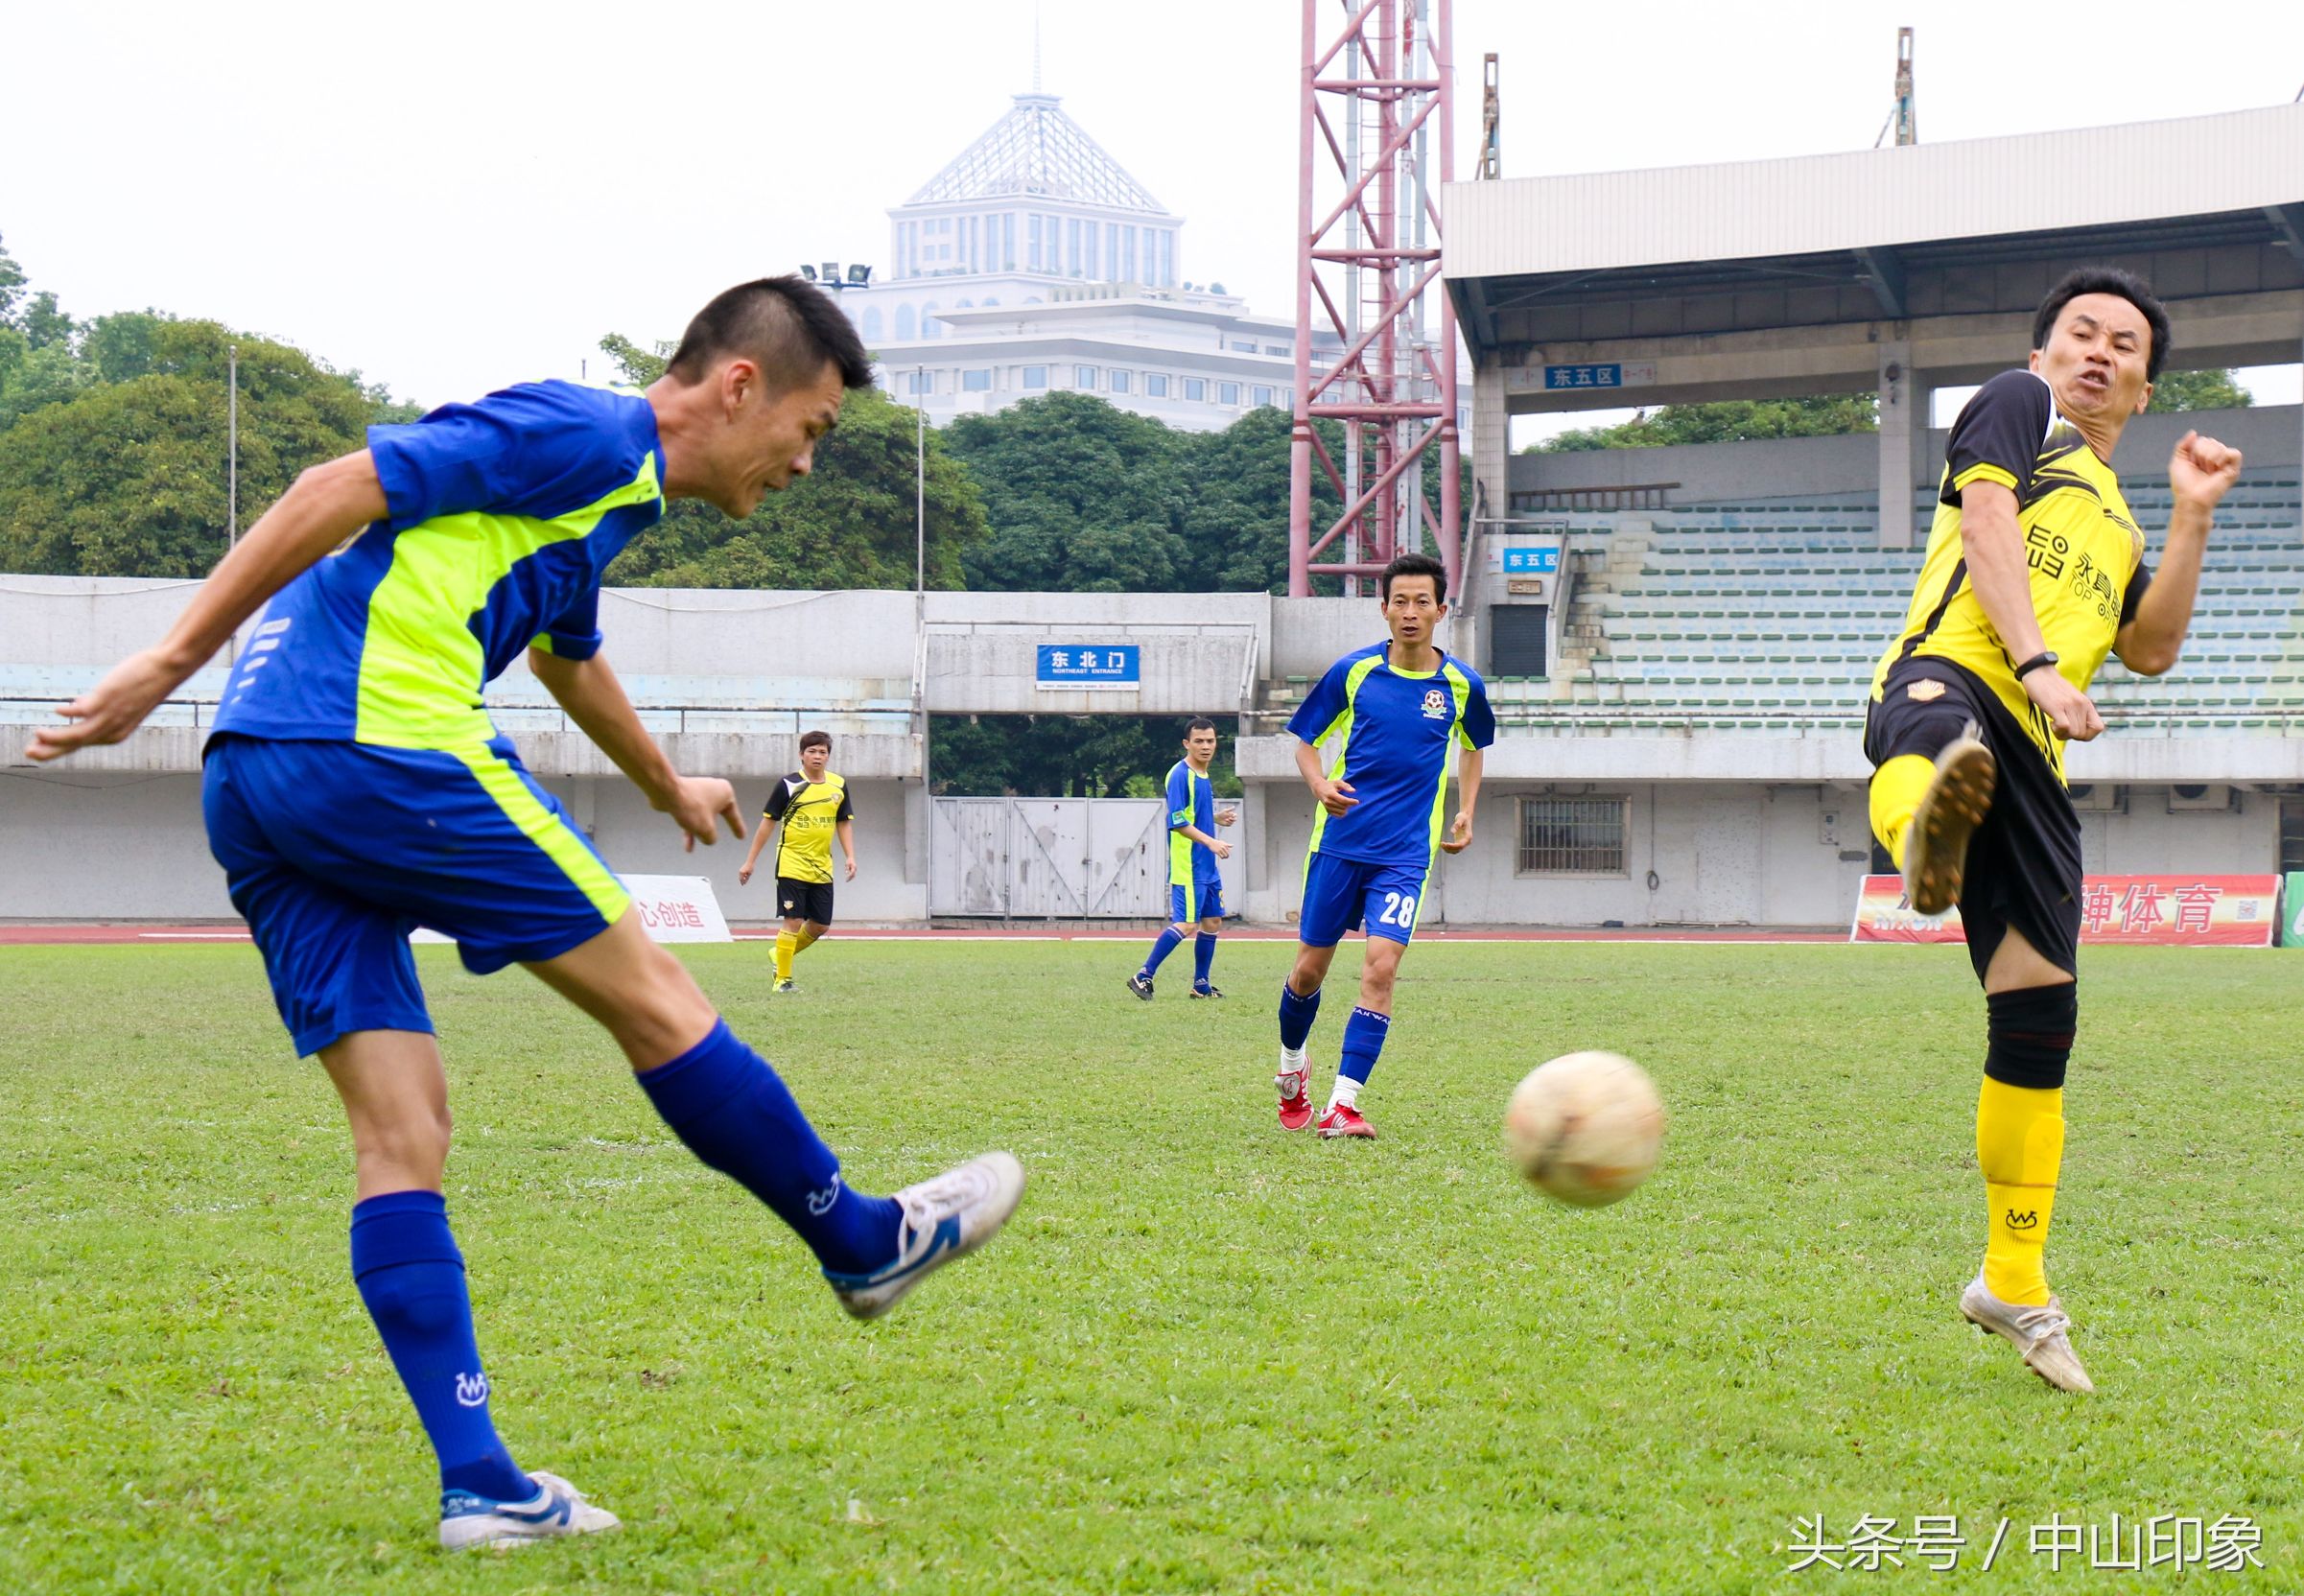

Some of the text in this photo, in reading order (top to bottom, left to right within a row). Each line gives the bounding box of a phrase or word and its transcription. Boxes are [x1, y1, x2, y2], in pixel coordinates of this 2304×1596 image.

[1553, 367, 1614, 387] 东五区
[1509, 553, 1559, 567] 东五区
[1051, 650, 1125, 669] 东北门
[1379, 892, 1415, 928] 28
